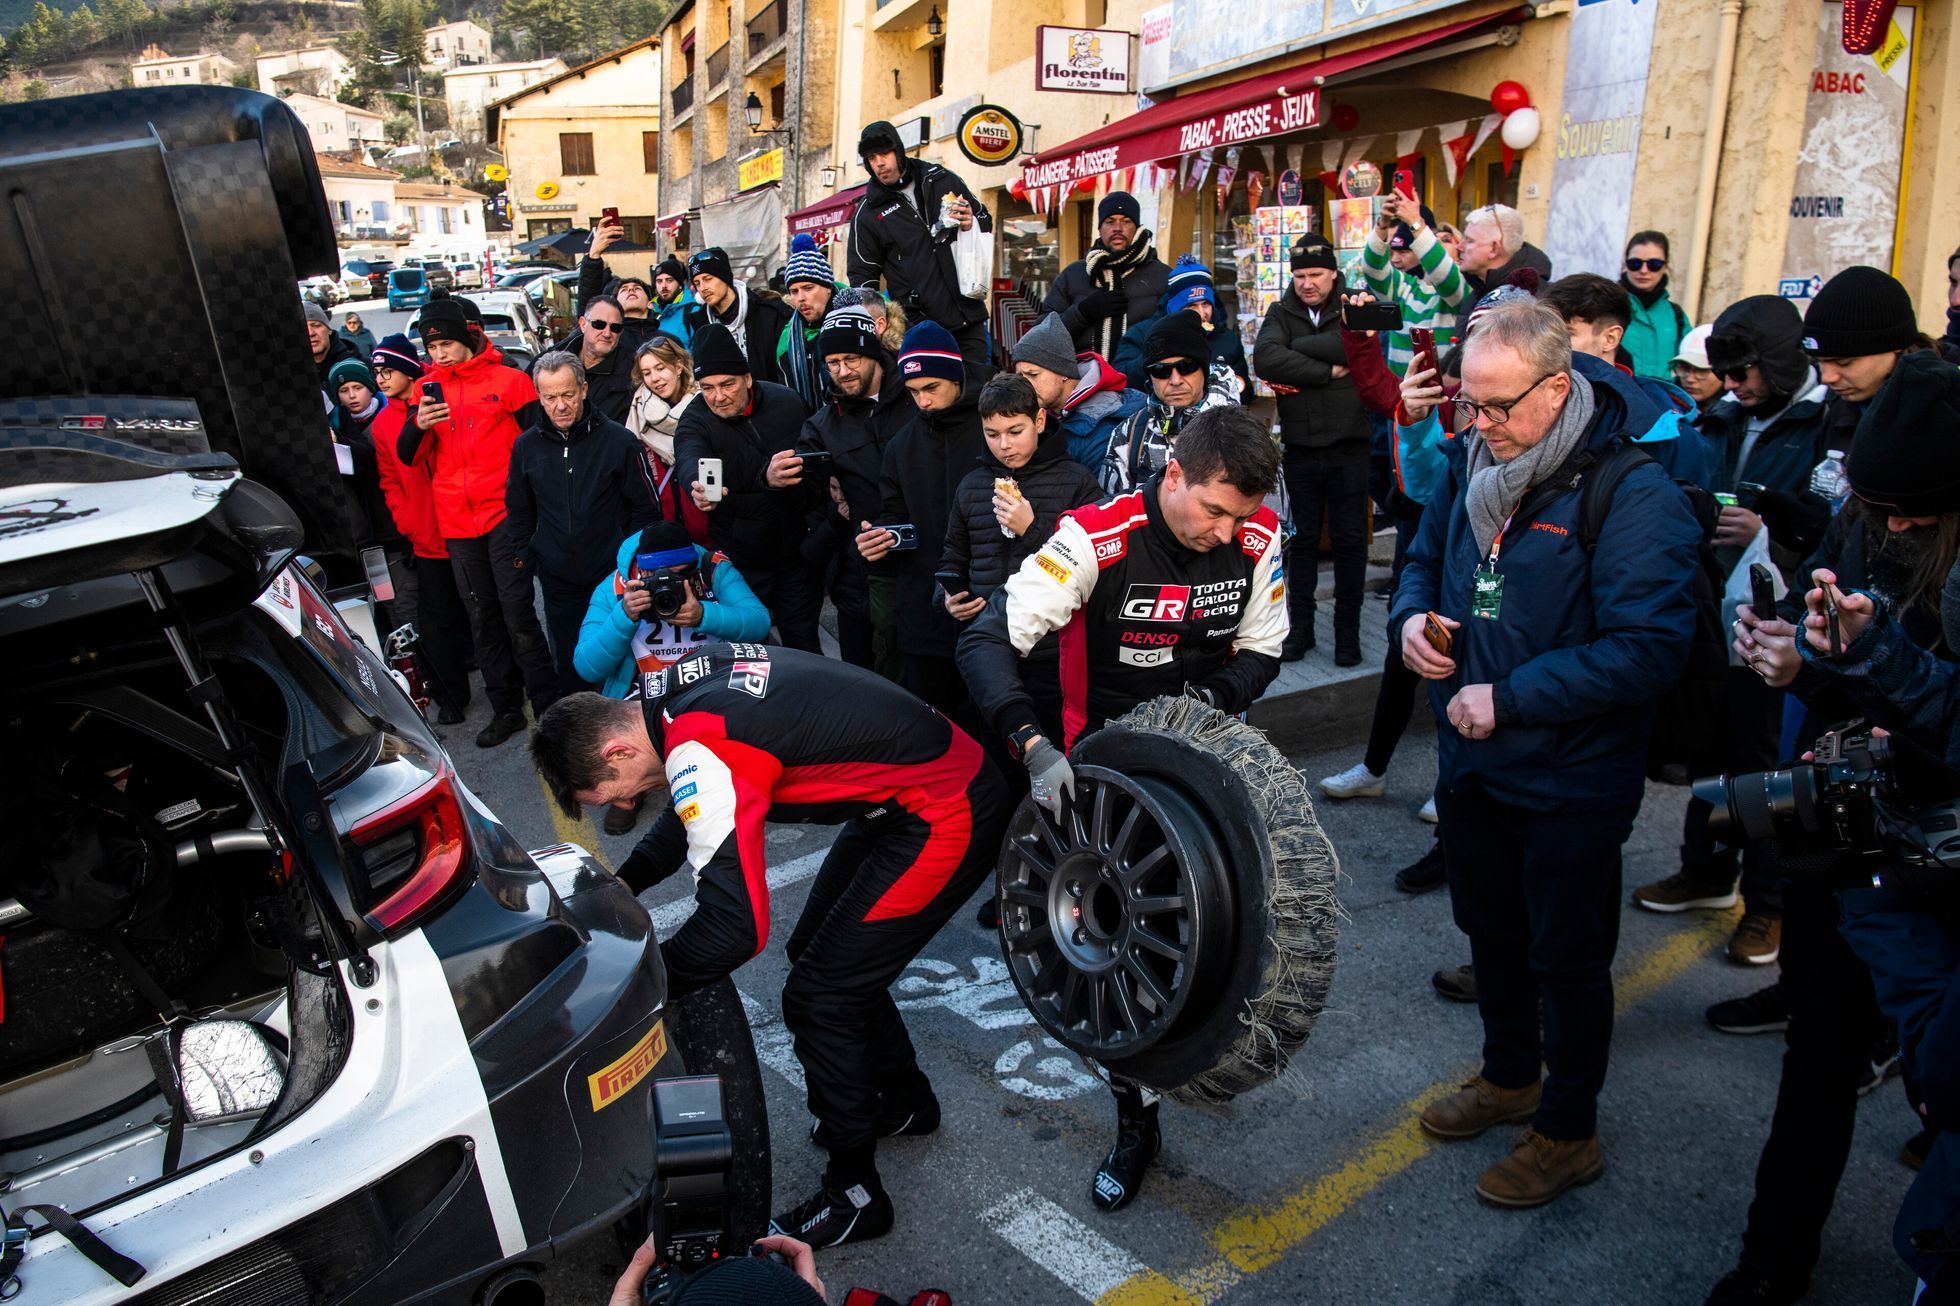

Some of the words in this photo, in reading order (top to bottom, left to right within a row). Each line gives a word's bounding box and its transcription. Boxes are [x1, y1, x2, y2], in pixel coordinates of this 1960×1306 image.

[1881, 41, 1905, 69] PRESSE
[1045, 63, 1125, 81] florentin
[1179, 118, 1216, 151] TABAC
[1221, 103, 1272, 142] PRESSE
[1279, 92, 1316, 130] JEUX
[975, 126, 1009, 138] AMSTEL
[1557, 102, 1642, 160] Souvenir
[1074, 145, 1120, 178] PÂTISSERIE
[1781, 282, 1804, 296] FDJ
[62, 419, 103, 429] GR
[113, 418, 200, 431] YARIS
[1051, 544, 1079, 567] AIRLINES
[1053, 540, 1071, 553] JAPAN
[1096, 540, 1122, 557] OMP
[1123, 599, 1184, 619] GR
[1192, 603, 1239, 621] Racing
[1120, 631, 1179, 645] DENSO
[649, 679, 661, 696] FIA
[744, 661, 769, 696] GR
[865, 807, 887, 819] EVANS
[597, 1029, 664, 1102] PIRELLI
[801, 1206, 831, 1233] one
